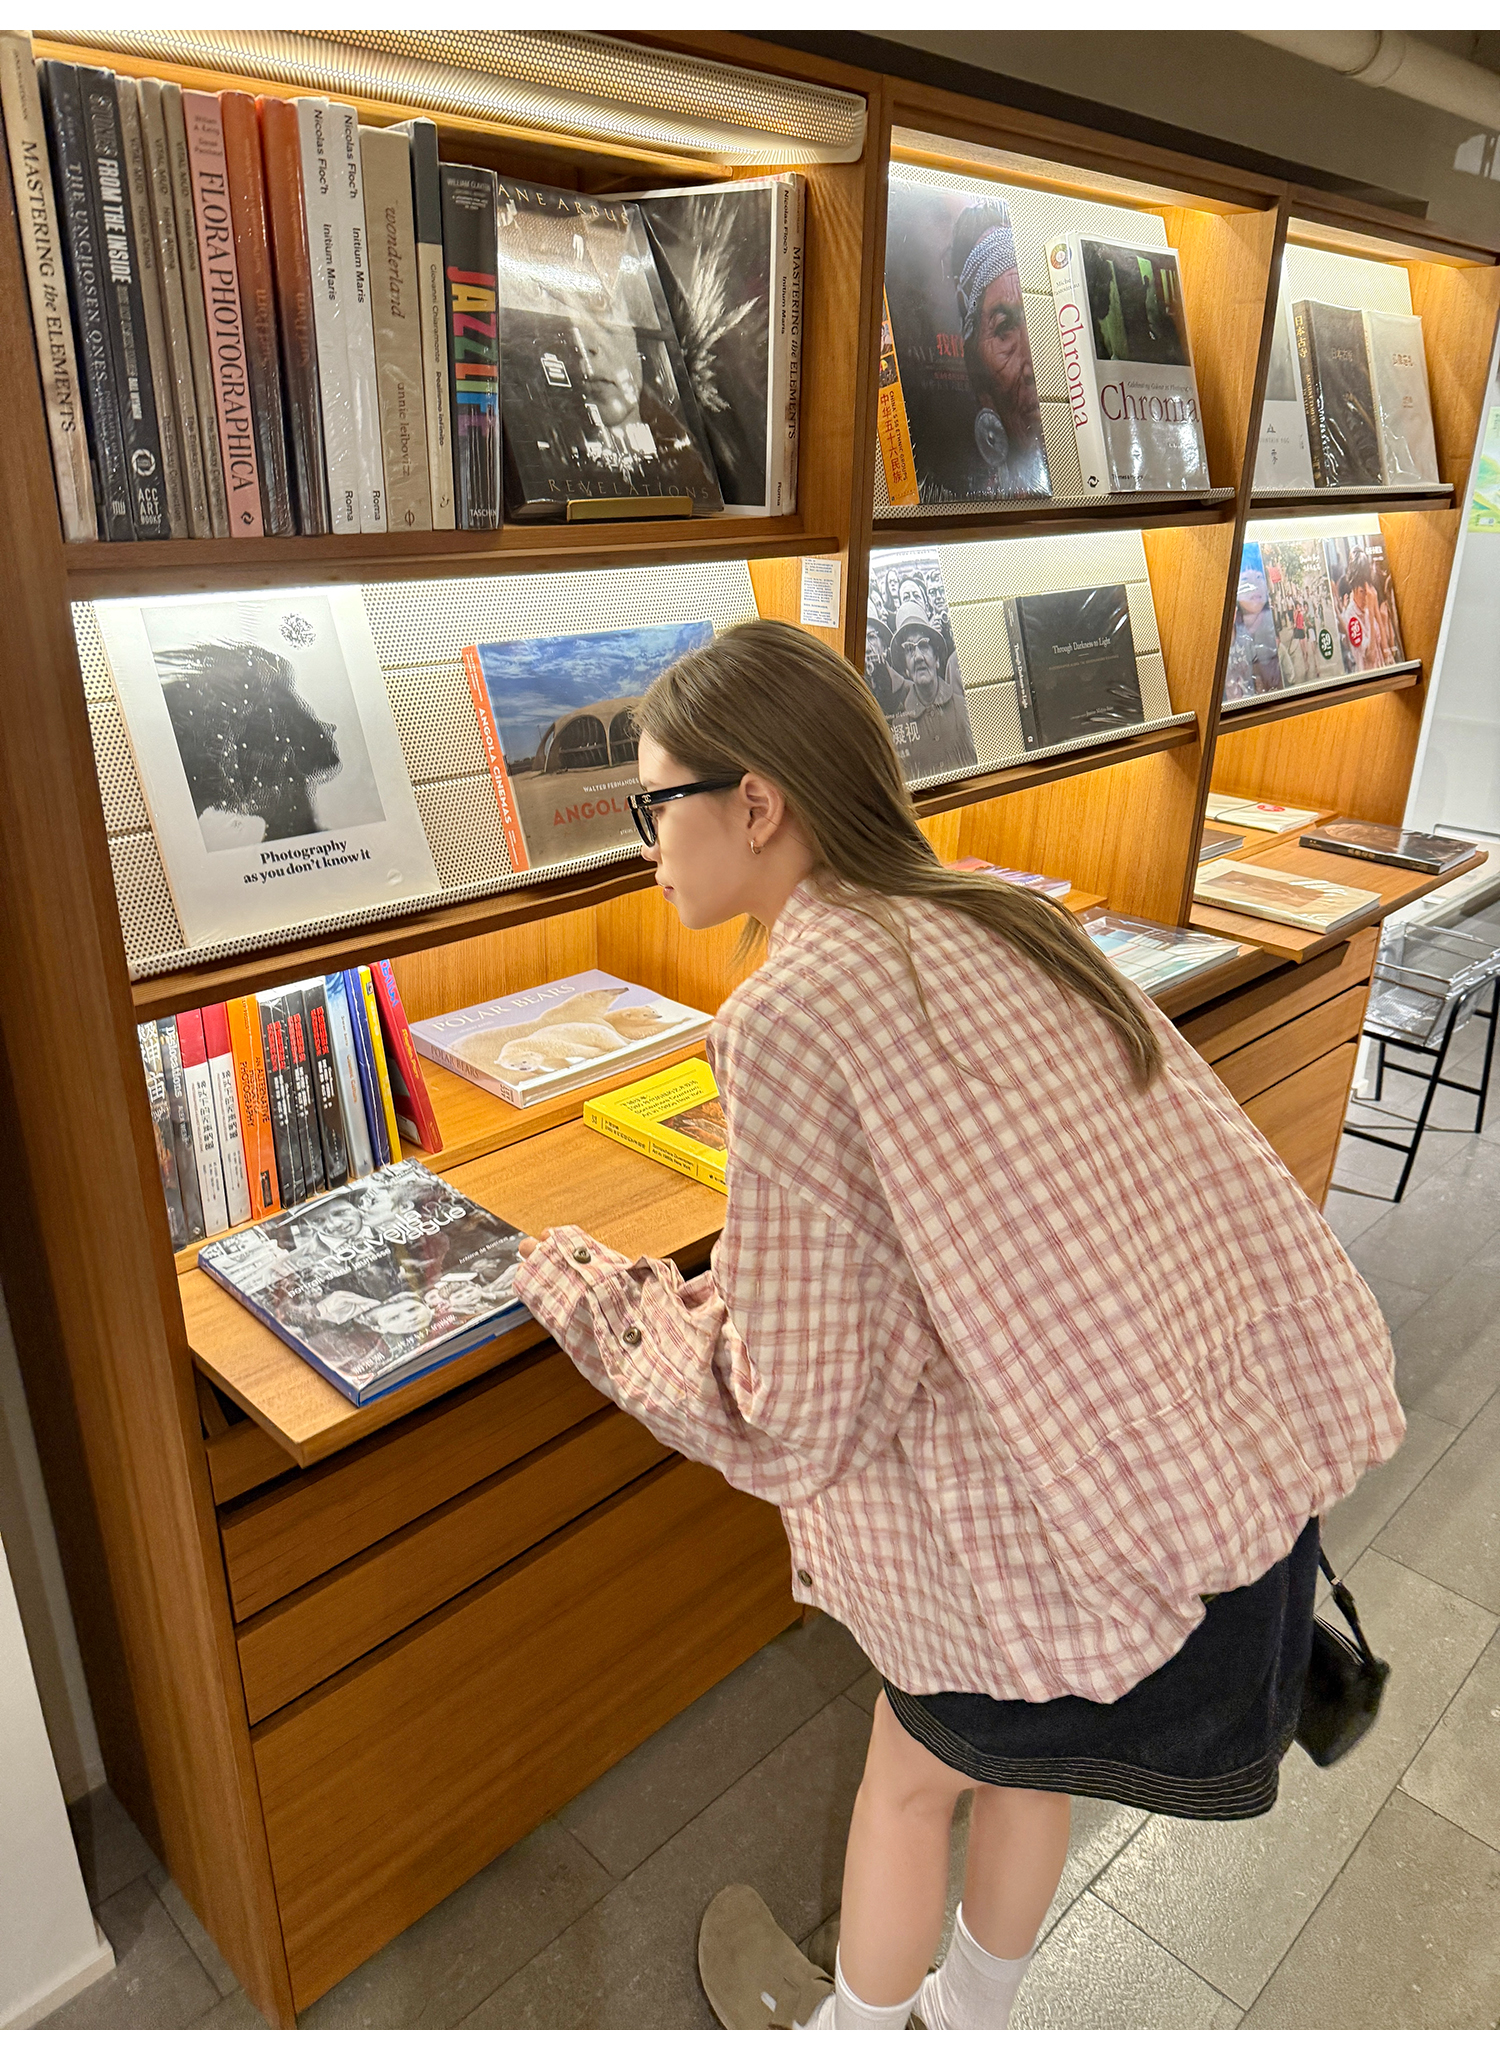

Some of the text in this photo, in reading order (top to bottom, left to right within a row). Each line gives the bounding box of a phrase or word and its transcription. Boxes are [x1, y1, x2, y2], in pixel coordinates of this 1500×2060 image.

[313, 108, 329, 195] Nicolas Floc'h
[343, 114, 359, 199] Nicolas Floc'h
[69, 161, 86, 203] THE
[97, 156, 122, 203] FROM
[447, 177, 470, 188] WILLIAM
[498, 183, 547, 207] ANE
[557, 198, 630, 225] ARBUS
[102, 204, 127, 235] THE
[199, 171, 231, 261] FLORA
[75, 211, 101, 319] UNCHOSEN
[106, 234, 133, 285] INSIDE
[323, 223, 336, 301] Initium Maris
[352, 227, 365, 303] Initium Maris
[385, 206, 406, 319] wonderland
[21, 140, 76, 433] MASTERING the ELEMENTS
[790, 246, 801, 336] MASTERING
[429, 263, 441, 363] Giovanni Chiaramonte
[1294, 315, 1309, 359] 日本古寺
[87, 329, 109, 382] ONES
[446, 266, 498, 436] JAZZLIFE
[790, 337, 799, 358] the
[1057, 303, 1090, 431] Chroma
[209, 268, 254, 492] PHOTOGRAPHICA
[396, 382, 406, 421] annie
[788, 360, 798, 440] ELEMENTS
[1101, 381, 1201, 423] Chroma
[880, 393, 903, 484] 中华五十六民族
[895, 428, 904, 452] ETHNIC
[138, 487, 159, 502] ACC
[139, 501, 160, 516] ART
[344, 489, 354, 522] Roma
[372, 489, 381, 521] Roma
[548, 478, 709, 500] REVELATIONS
[140, 514, 163, 526] BOOKS
[1014, 643, 1022, 667] Through
[1052, 642, 1074, 655] Through
[1072, 640, 1094, 651] Darkness
[1098, 636, 1112, 649] Light
[478, 707, 512, 825] ANGOLA CINEMAS
[583, 783, 607, 793] WALTER
[243, 848, 372, 884] as you don't know it
[260, 838, 349, 865] Photography
[431, 983, 576, 1032] POLAR BEARS
[165, 1024, 183, 1099] Dislocations
[430, 1045, 480, 1079] POLAR BEARS
[240, 1061, 255, 1127] PHOTOGRAPHY
[257, 1068, 269, 1123] ALTERNATIVE
[318, 1217, 422, 1271] nouvelle
[391, 1206, 467, 1245] vague
[287, 1276, 324, 1300] portrait
[350, 1248, 392, 1271] jeunesse
